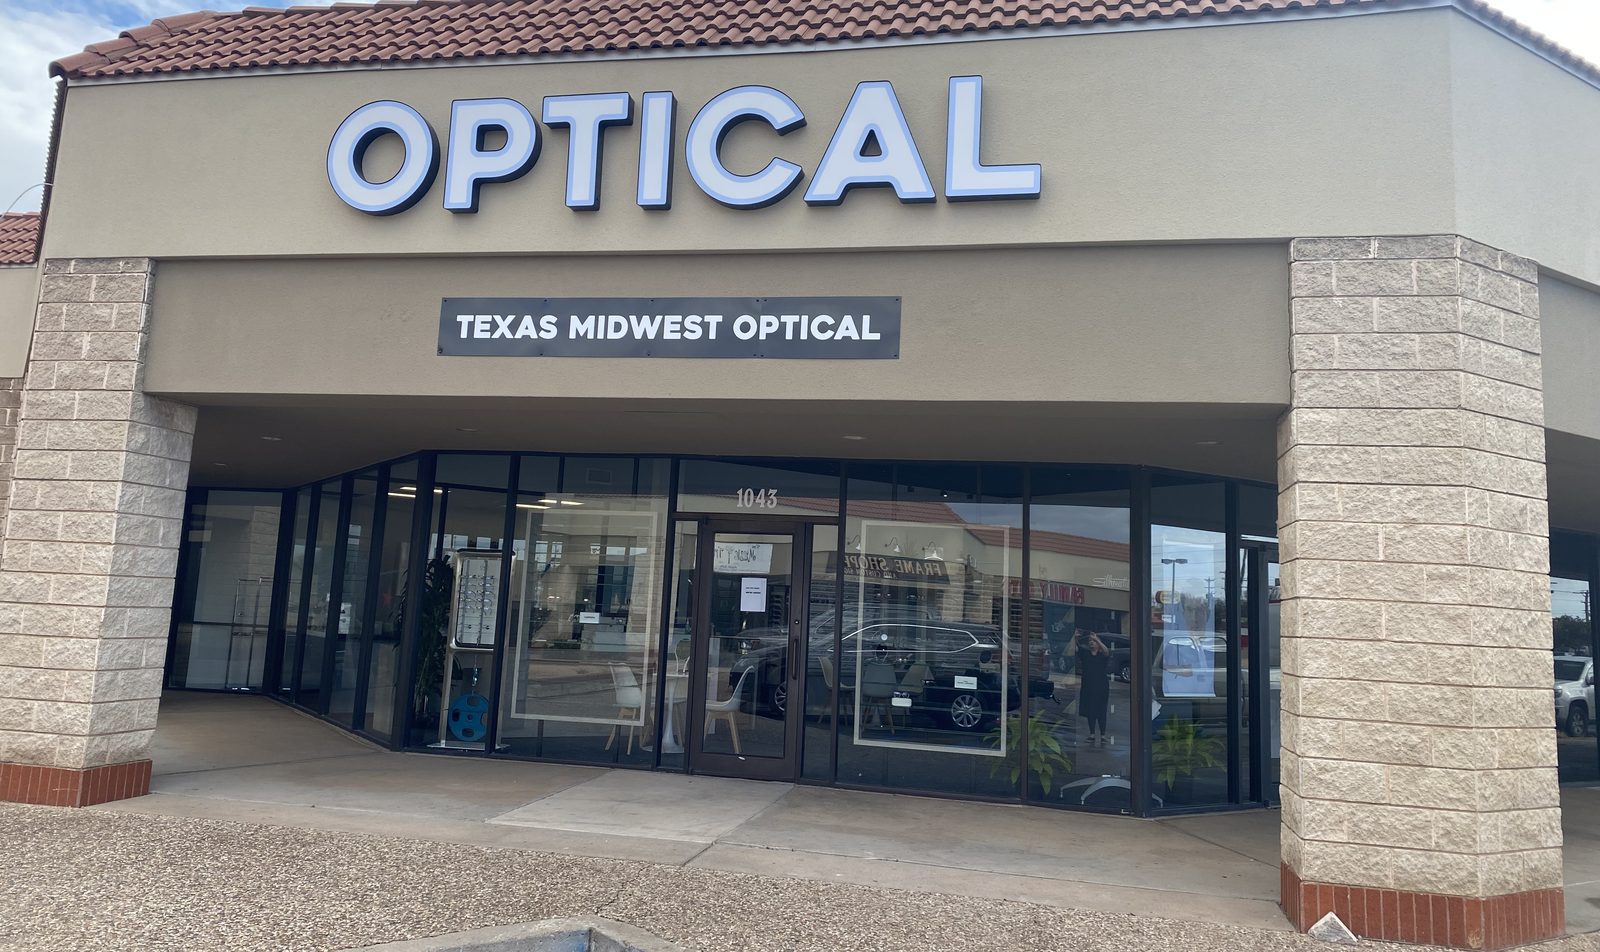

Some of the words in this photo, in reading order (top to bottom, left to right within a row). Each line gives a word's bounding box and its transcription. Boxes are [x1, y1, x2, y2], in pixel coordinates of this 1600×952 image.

[326, 75, 1042, 215] OPTICAL
[456, 314, 558, 340] TEXAS
[568, 315, 723, 341] MIDWEST
[732, 314, 881, 341] OPTICAL
[736, 488, 778, 509] 1043
